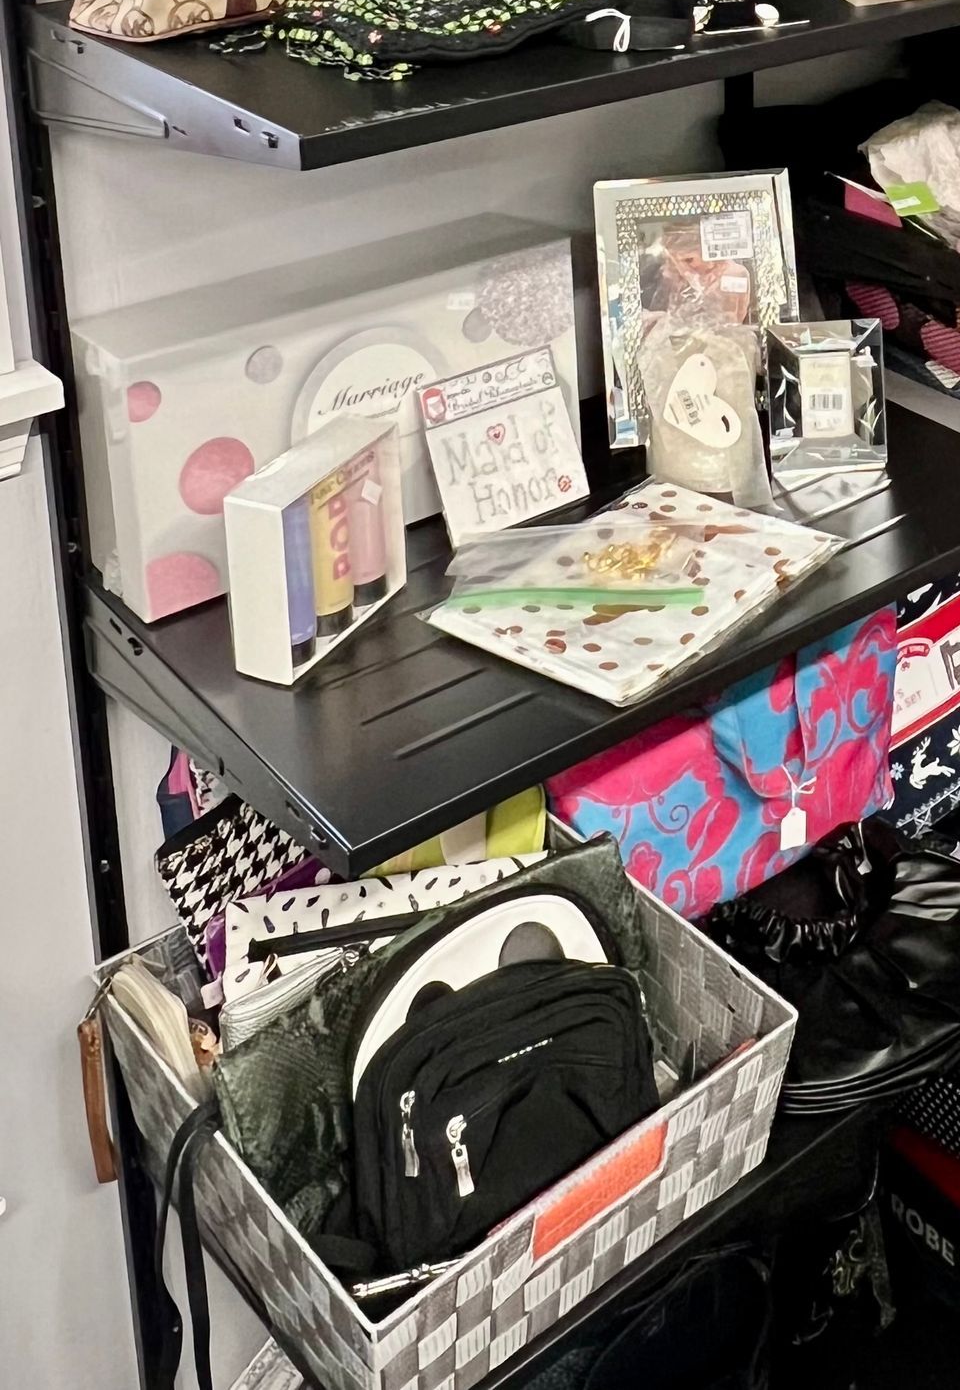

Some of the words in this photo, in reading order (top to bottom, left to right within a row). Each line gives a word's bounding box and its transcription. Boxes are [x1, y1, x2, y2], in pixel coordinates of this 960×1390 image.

[318, 371, 424, 415] Marriage
[442, 413, 530, 483] Maid
[468, 467, 558, 524] Honor
[891, 1193, 955, 1267] ROBE
